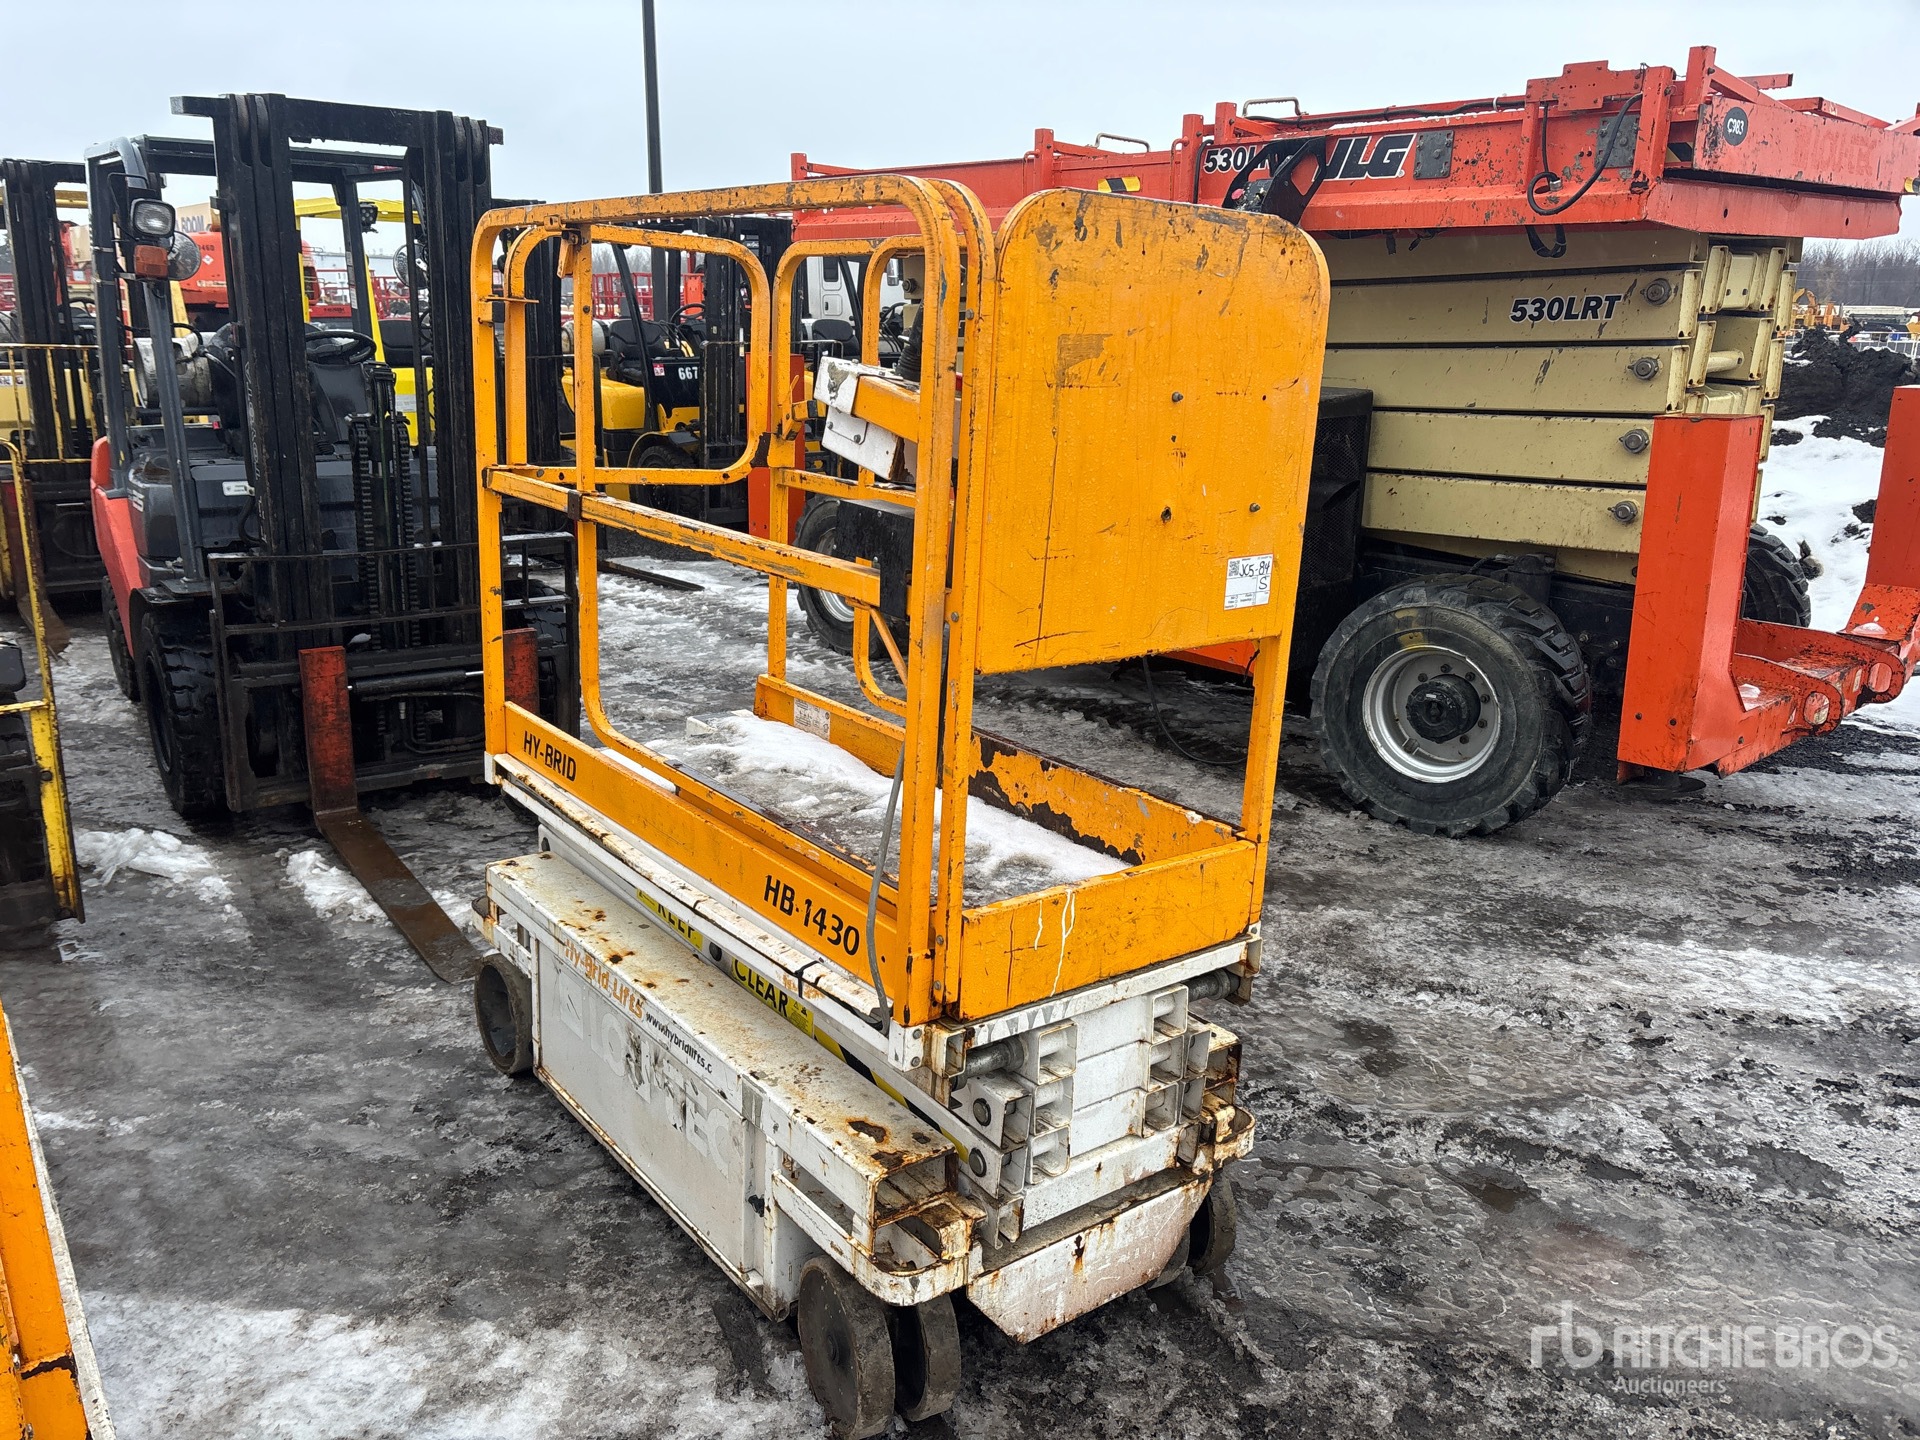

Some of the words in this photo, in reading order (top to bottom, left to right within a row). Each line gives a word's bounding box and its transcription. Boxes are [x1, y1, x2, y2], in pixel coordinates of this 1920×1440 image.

[1312, 133, 1417, 181] JLG
[1509, 295, 1623, 323] 530LRT
[678, 366, 698, 380] 667
[523, 730, 577, 782] HY-BRID
[734, 957, 789, 1018] CLEAR
